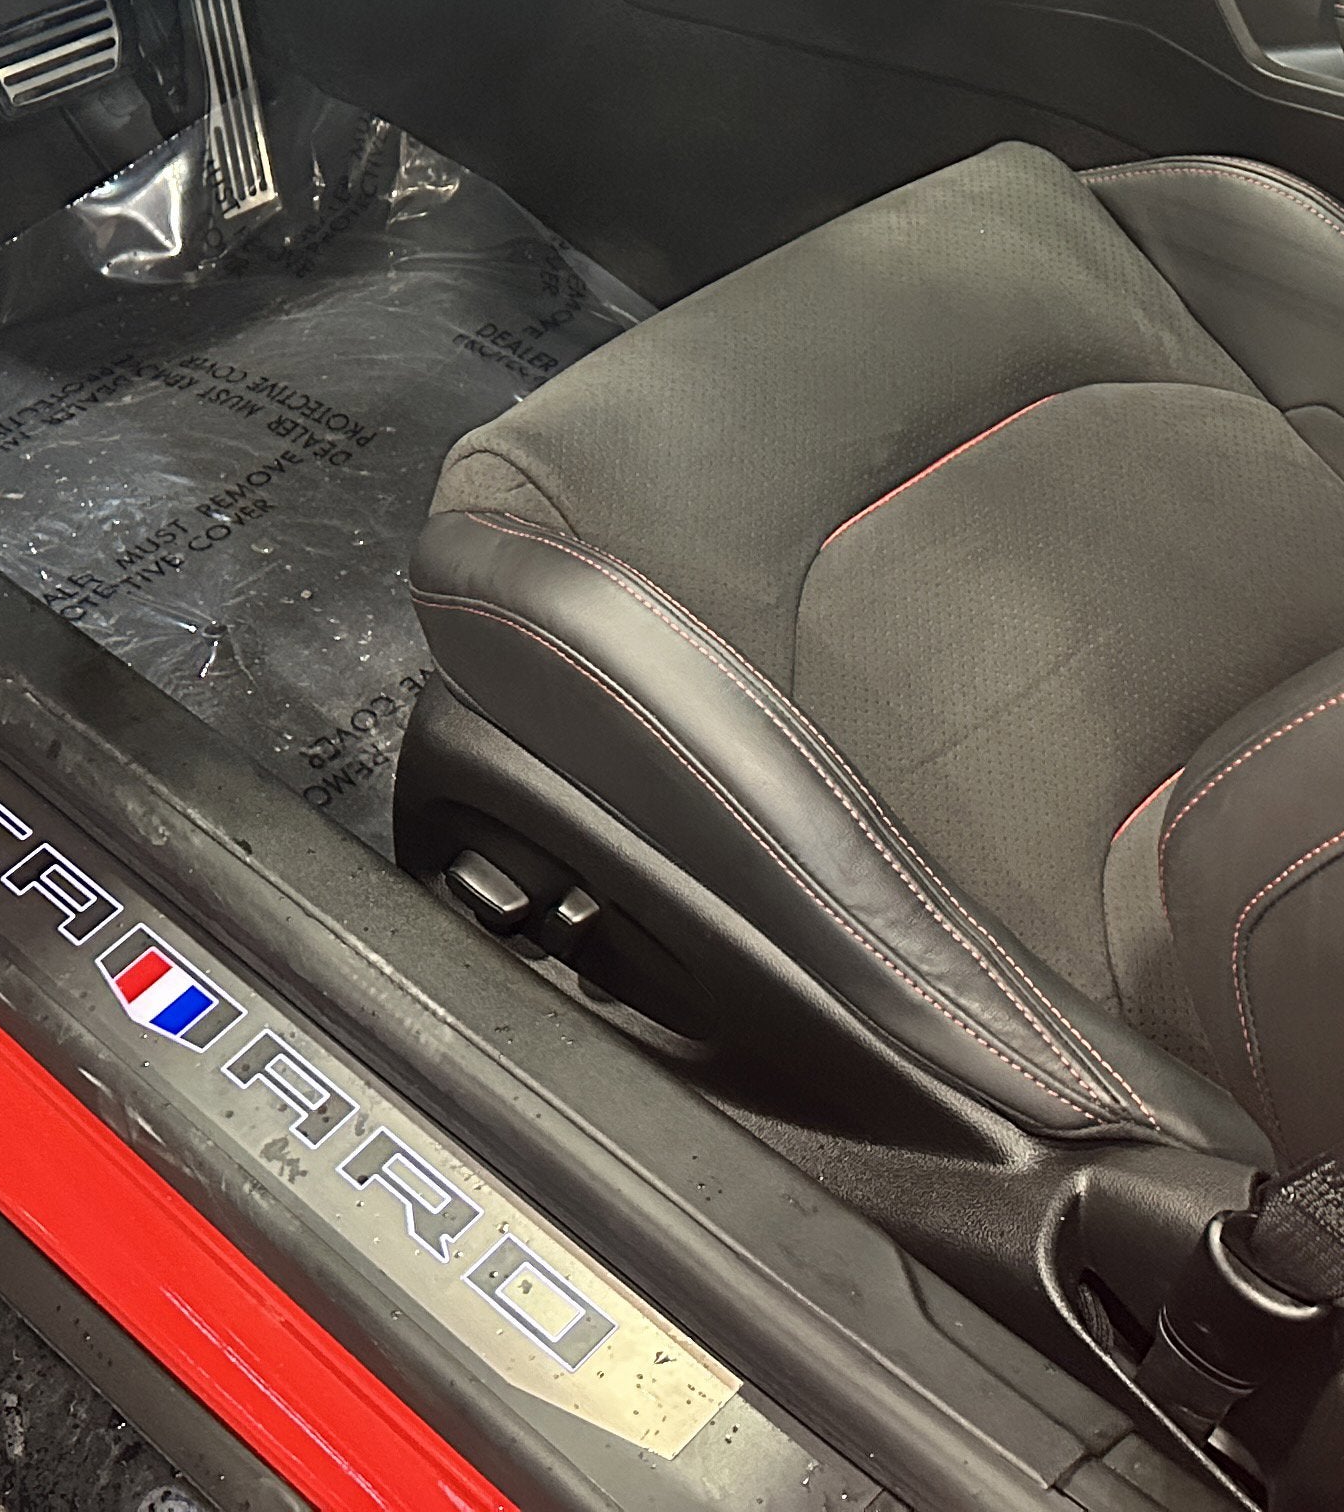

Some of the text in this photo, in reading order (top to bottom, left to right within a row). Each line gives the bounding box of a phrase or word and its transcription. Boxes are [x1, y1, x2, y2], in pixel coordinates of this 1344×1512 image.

[476, 321, 559, 373] DEALER
[196, 385, 265, 419] MUST
[246, 375, 378, 449] PROTECTIVE
[266, 413, 353, 467] DEALER
[115, 518, 189, 571] MUST
[194, 449, 305, 517] REMOVE
[188, 498, 278, 552] COVER
